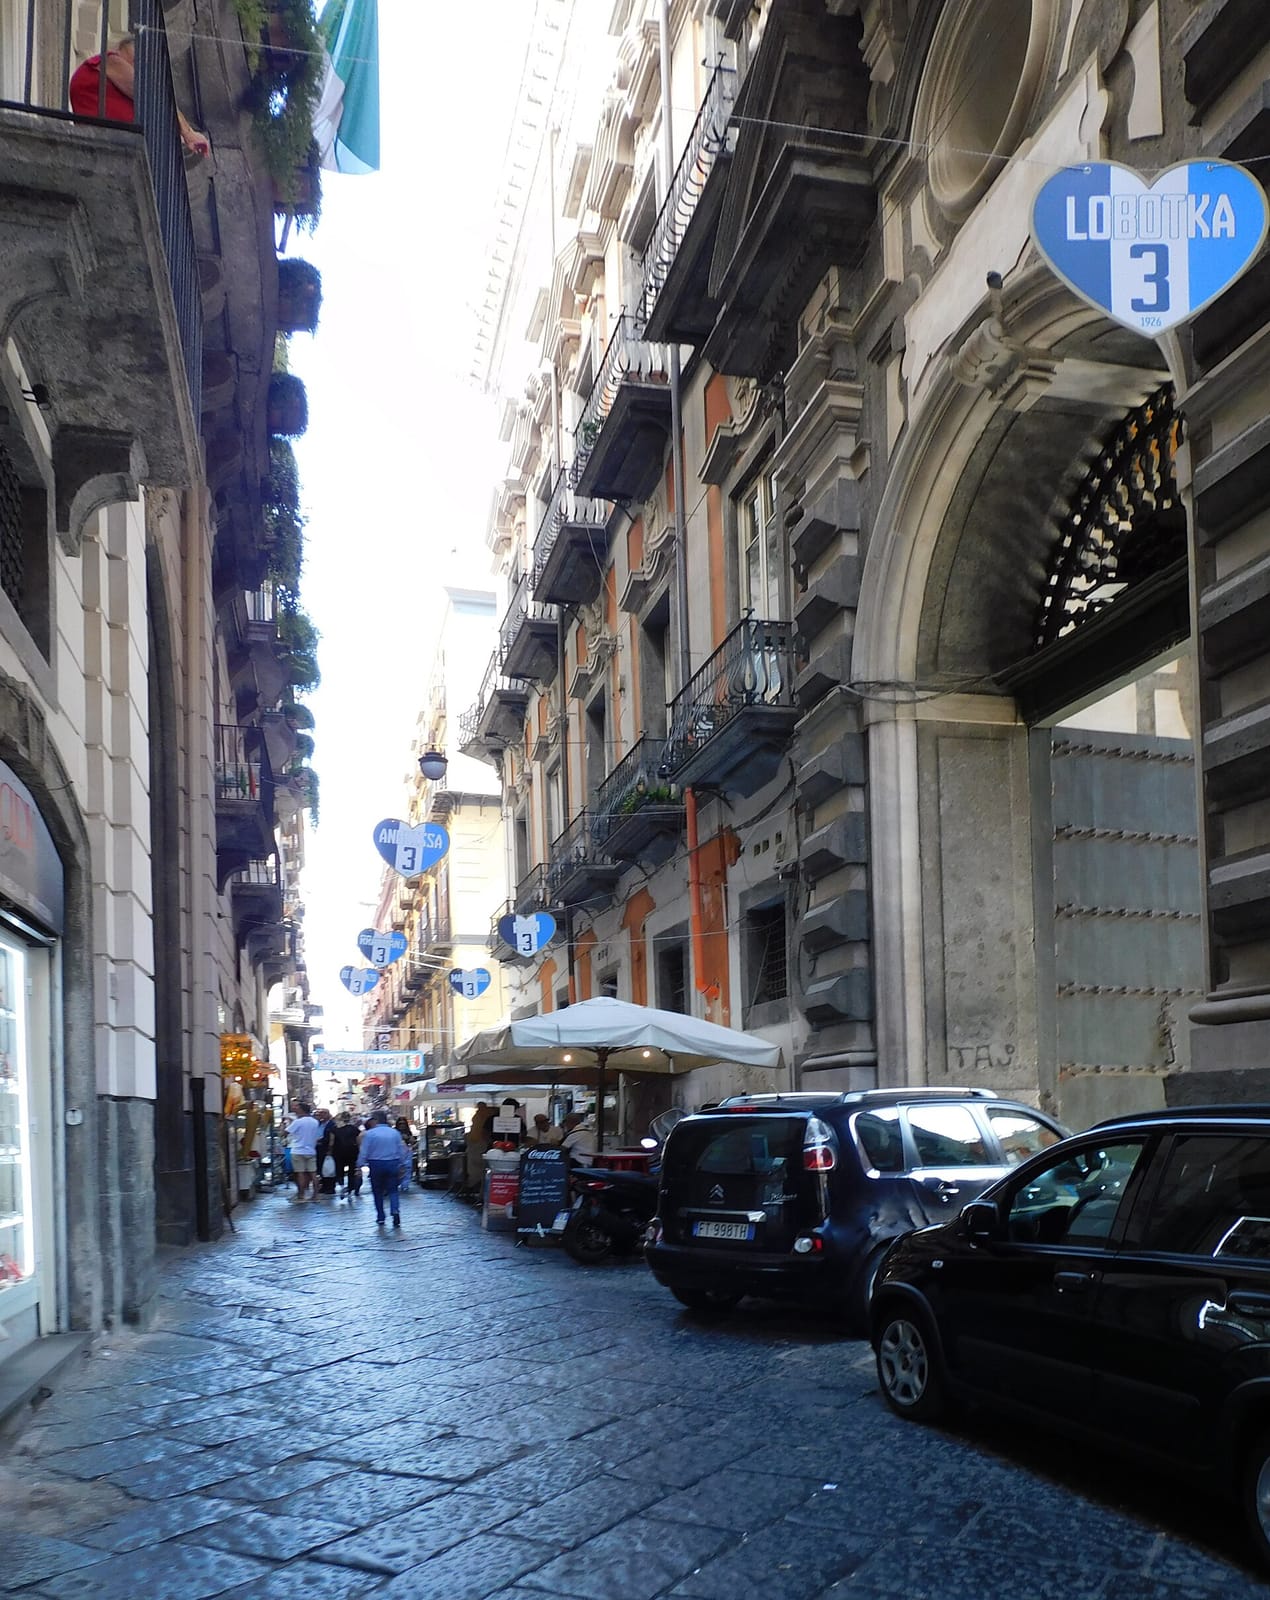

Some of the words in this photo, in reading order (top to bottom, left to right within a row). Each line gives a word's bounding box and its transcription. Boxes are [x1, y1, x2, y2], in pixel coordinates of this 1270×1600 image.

[1066, 194, 1236, 241] LOBOTKA
[1130, 243, 1171, 313] 3
[1141, 316, 1162, 328] 1926
[402, 846, 417, 871] 3
[522, 933, 532, 951] 3
[376, 947, 386, 963] 3
[353, 980, 361, 993] 3
[466, 982, 475, 996] 3
